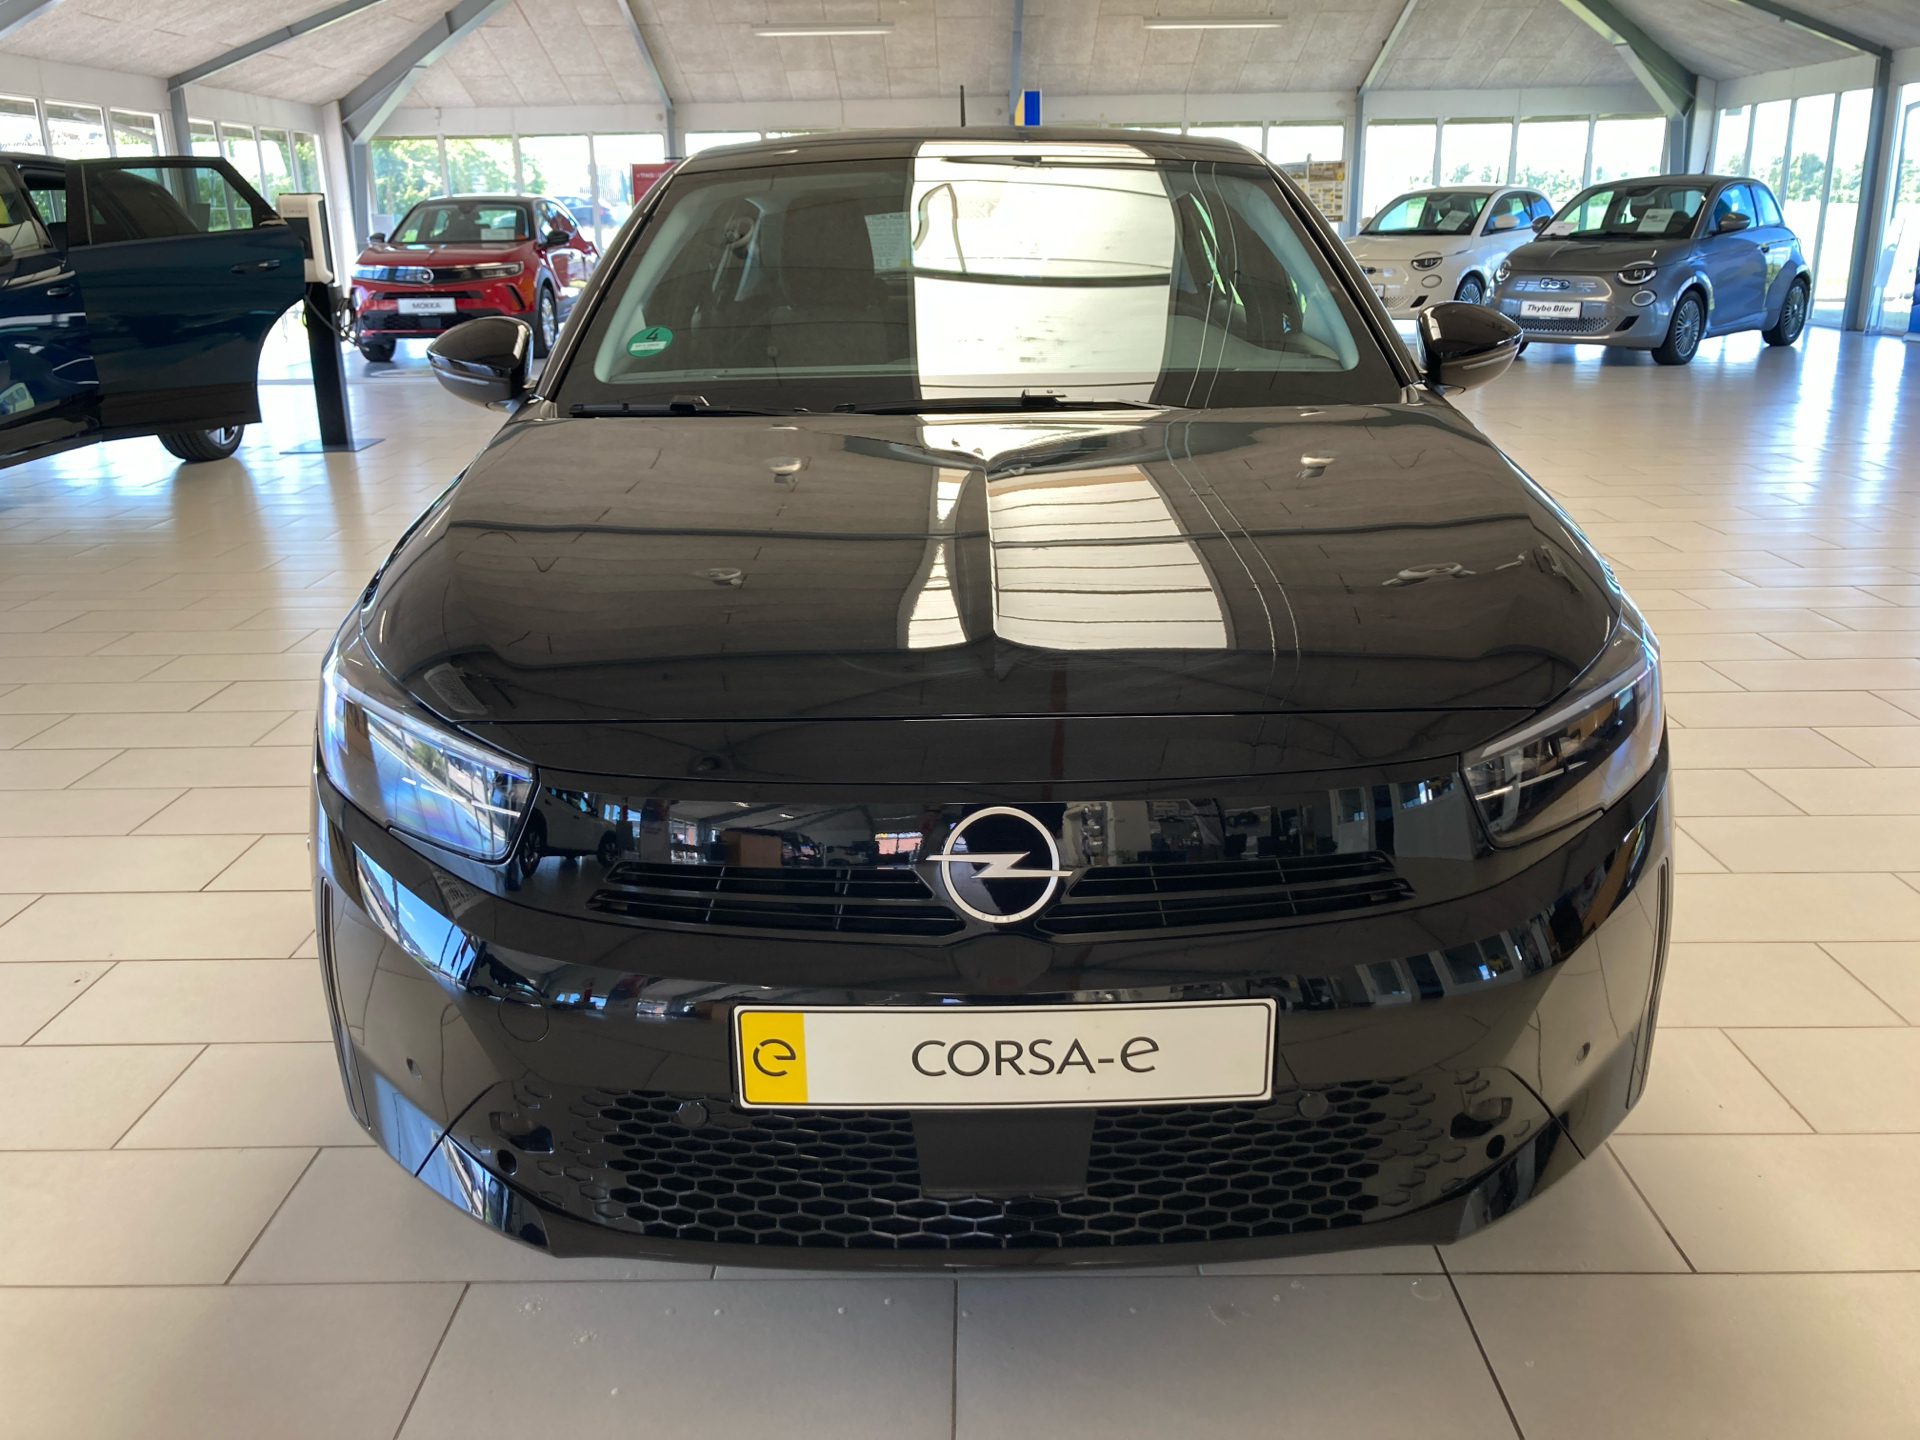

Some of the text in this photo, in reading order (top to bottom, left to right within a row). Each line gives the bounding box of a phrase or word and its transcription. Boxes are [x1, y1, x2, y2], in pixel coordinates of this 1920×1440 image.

[1527, 304, 1574, 313] Thybo Biler
[645, 327, 660, 342] 4
[911, 1036, 1160, 1077] CORSA-e
